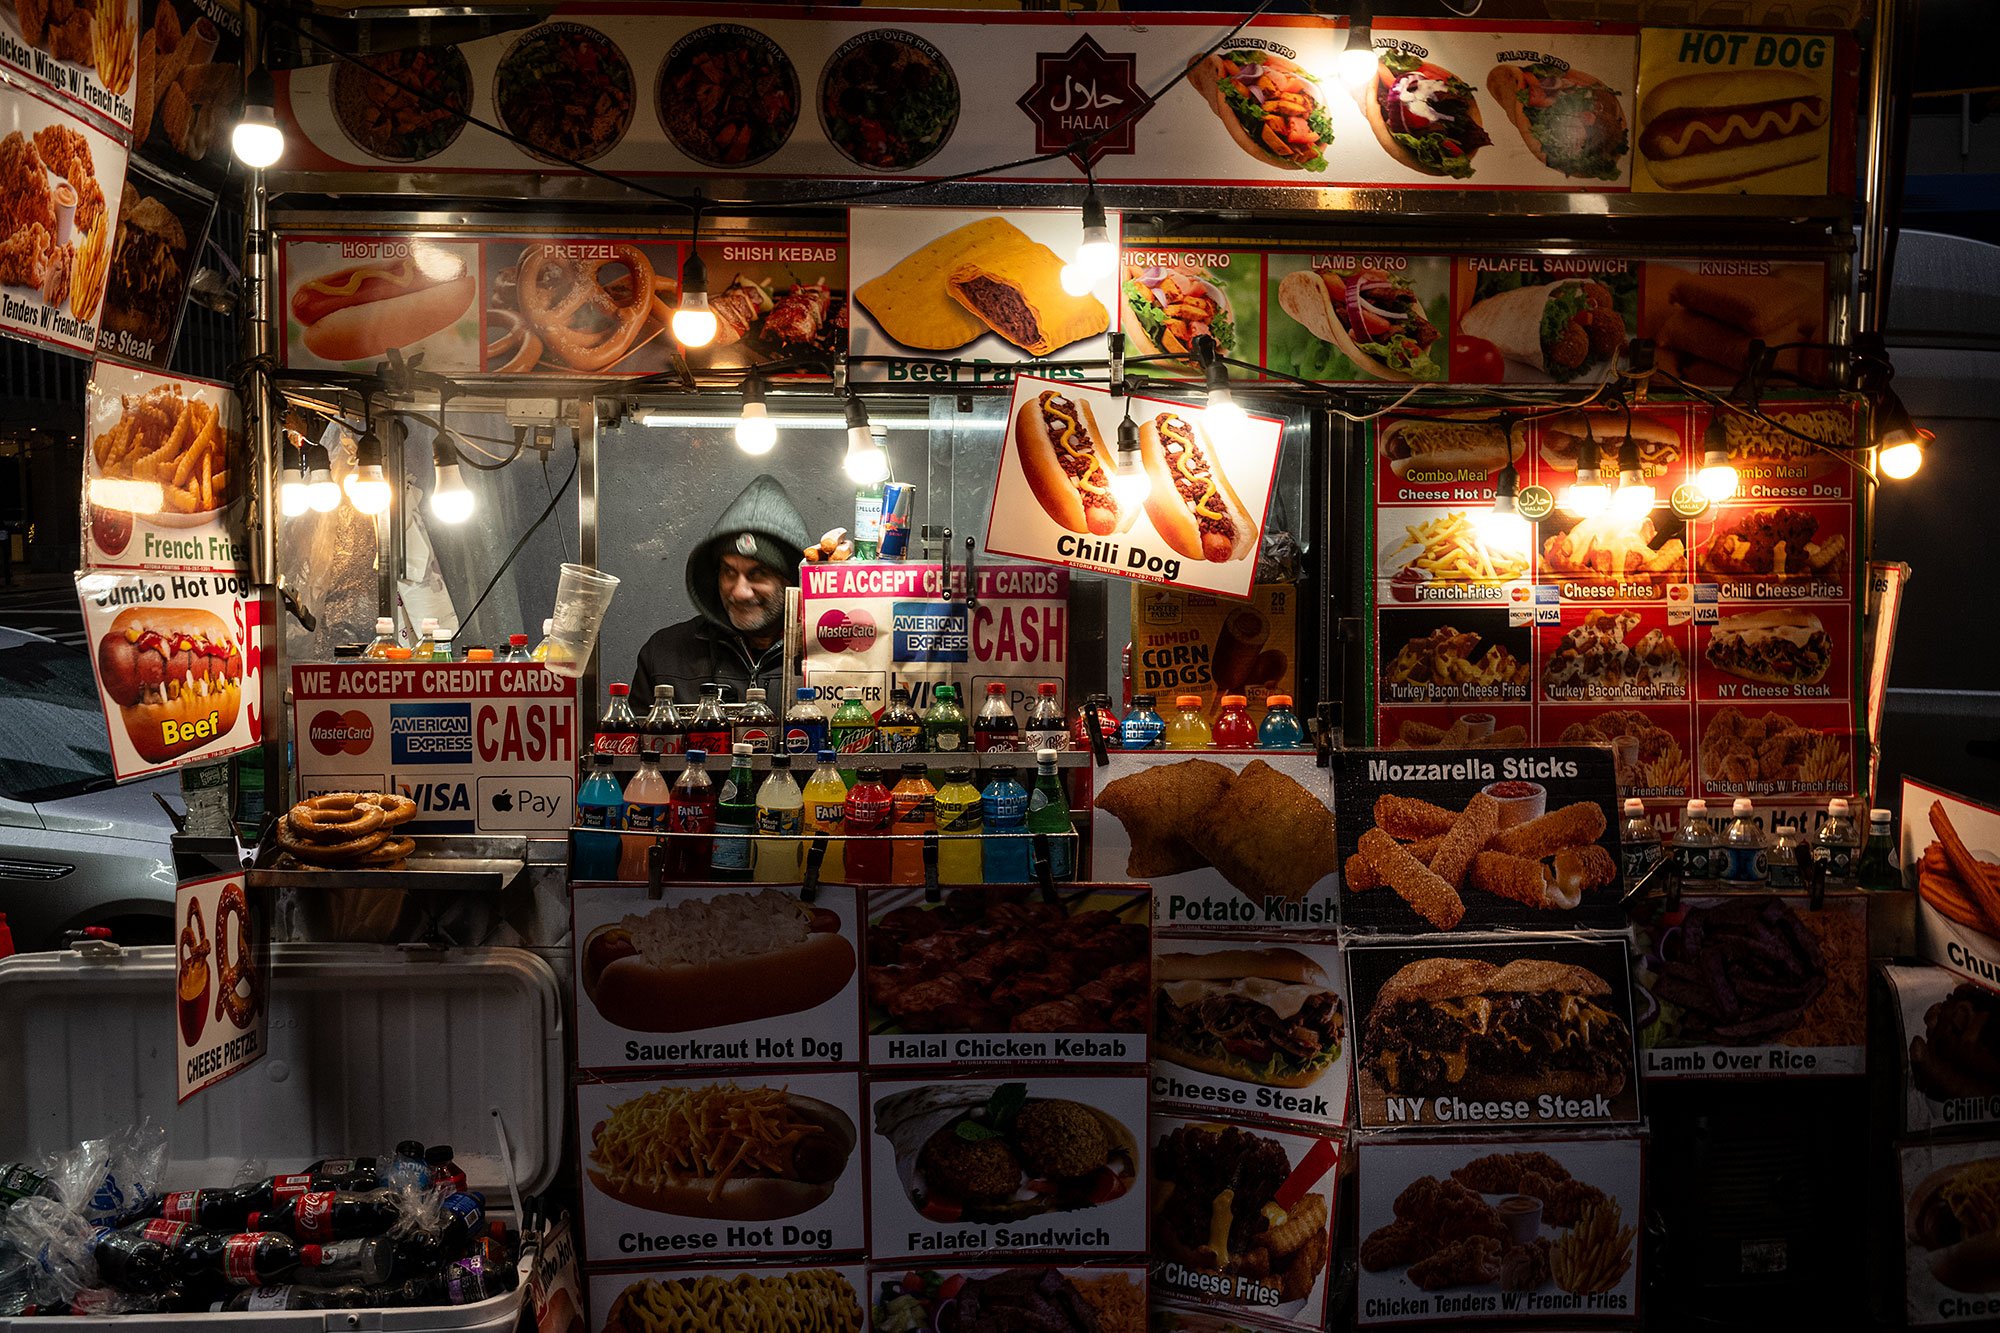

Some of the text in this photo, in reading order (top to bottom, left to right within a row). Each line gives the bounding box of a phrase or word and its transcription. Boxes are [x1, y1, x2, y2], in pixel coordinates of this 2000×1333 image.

[519, 22, 609, 48] LAMB OVER RICE
[669, 26, 717, 59] CHICKEN
[731, 25, 764, 45] LAMB
[763, 41, 786, 63] MIX
[835, 30, 941, 62] FALAFEL OVER RICE
[1267, 40, 1297, 60] GYRO
[1374, 38, 1429, 59] AMB GYRO
[1678, 32, 1827, 69] HOT DOG
[1496, 50, 1570, 72] FALAFEL GYRO
[33, 48, 67, 89] Wings
[83, 77, 112, 116] French
[113, 96, 133, 125] Fries
[1050, 75, 1125, 112] حلال
[1061, 115, 1110, 130] HALAL
[342, 241, 379, 259] HOT
[543, 244, 620, 261] PRETZEL
[723, 246, 838, 263] SHISH KEBAB
[1121, 252, 1231, 269] HICKEN GYRO
[1311, 255, 1408, 271] LAMB GYRO
[1468, 257, 1629, 274] FALAFEL SANDWICH
[1700, 261, 1771, 277] KNISHES
[2, 293, 39, 326] Tenders
[53, 309, 79, 337] French
[79, 318, 96, 344] Fries
[118, 329, 156, 362] Steak
[887, 357, 962, 383] Beef
[1406, 468, 1489, 482] Combo Meal
[1736, 464, 1808, 479] ombo Meal
[1398, 488, 1479, 500] Cheese Hot
[1750, 485, 1808, 497] Cheese
[1812, 484, 1843, 499] Dog
[144, 532, 249, 562] French Fries
[1056, 535, 1182, 581] Chili Dog
[1068, 561, 1093, 570] ASTORIA
[1093, 565, 1121, 575] PRINTING
[171, 576, 251, 599] Hot Dog
[808, 569, 1058, 595] WE ACCEPT CARDS
[1414, 584, 1465, 600] French
[1466, 584, 1503, 600] Fries
[1563, 582, 1615, 598] Cheese
[1619, 582, 1653, 598] Fries
[1721, 582, 1752, 598] Chili
[1755, 582, 1807, 598] Cheese
[1810, 582, 1844, 598] Fries
[1147, 604, 1180, 613] FOSTER
[1150, 609, 1177, 619] FARMS
[1538, 609, 1560, 620] VISA
[1696, 608, 1718, 619] VISA
[816, 624, 876, 639] MasterCard
[892, 615, 965, 631] AMERICAN
[907, 635, 969, 651] EXPRESS
[971, 604, 1064, 664] CASH
[1147, 629, 1201, 647] JUMBO
[1141, 643, 1211, 669] CORN
[299, 668, 565, 695] WE ACCEPT CREDIT CARDS
[1144, 663, 1212, 690] DOGS
[1390, 681, 1527, 701] Turkey Bacon Cheese Fries
[1549, 682, 1686, 700] Turkey Bacon Ranch Fries
[1718, 683, 1831, 698] NY Cheese Steak
[160, 709, 220, 747] Beef
[310, 726, 373, 741] MasterCard
[391, 717, 468, 733] AMERICAN
[476, 703, 572, 763] CASH
[1126, 721, 1161, 731] POWER
[408, 737, 473, 751] EXPRESS
[1368, 757, 1579, 782] Mozzarella Sticks
[402, 783, 471, 811] VISA
[1632, 786, 1686, 797] French Fries
[1705, 779, 1849, 794] Chicken Wings French Fries
[518, 791, 561, 818] Pay
[677, 805, 704, 816] FANTA
[1771, 810, 1807, 834] Hot
[1169, 895, 1338, 922] Potato Knish
[186, 1046, 223, 1084] CHEESE
[224, 1028, 259, 1066] PRETZEL
[625, 1036, 843, 1062] Sauerkraut Hot Dog
[889, 1038, 1127, 1059] Halal Chicken Kebab
[1647, 1050, 1817, 1071] Lamb Over Rice
[1151, 1076, 1330, 1116] Cheese Steak
[1386, 1093, 1612, 1122] NY Cheese Steak
[1942, 1098, 1985, 1122] Chili
[618, 1225, 833, 1253] Cheese Hot Dog
[908, 1228, 1111, 1251] Falafel Sandwich
[1164, 1261, 1232, 1296] Cheese
[1235, 1275, 1281, 1307] Fries
[1365, 1297, 1430, 1318] Chicken
[1434, 1294, 1497, 1314] Tenders
[1526, 1291, 1583, 1310] French
[1587, 1290, 1628, 1309] Fries
